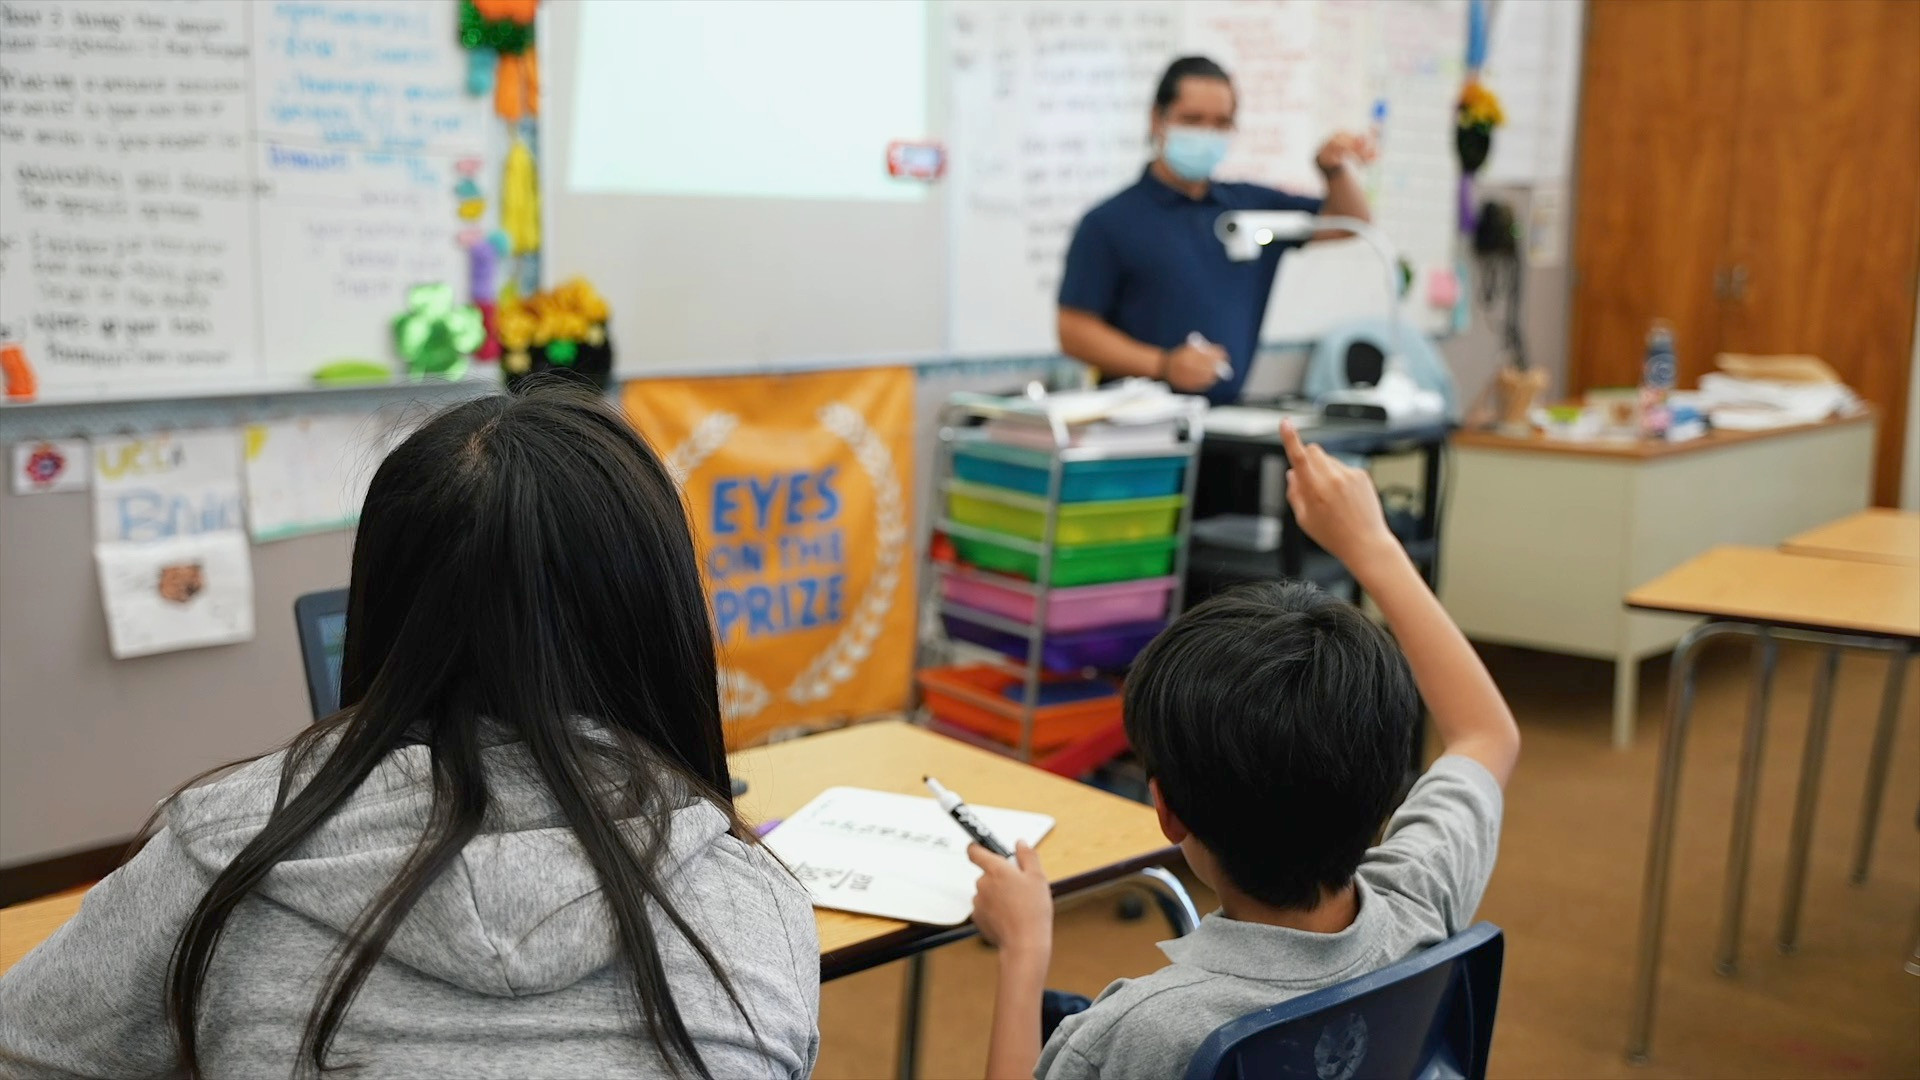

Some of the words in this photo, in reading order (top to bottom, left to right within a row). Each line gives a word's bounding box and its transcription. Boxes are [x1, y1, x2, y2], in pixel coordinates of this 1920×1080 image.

[711, 465, 842, 535] EYES
[707, 544, 764, 581] ON
[778, 530, 844, 570] THE
[713, 574, 845, 642] PRIZE
